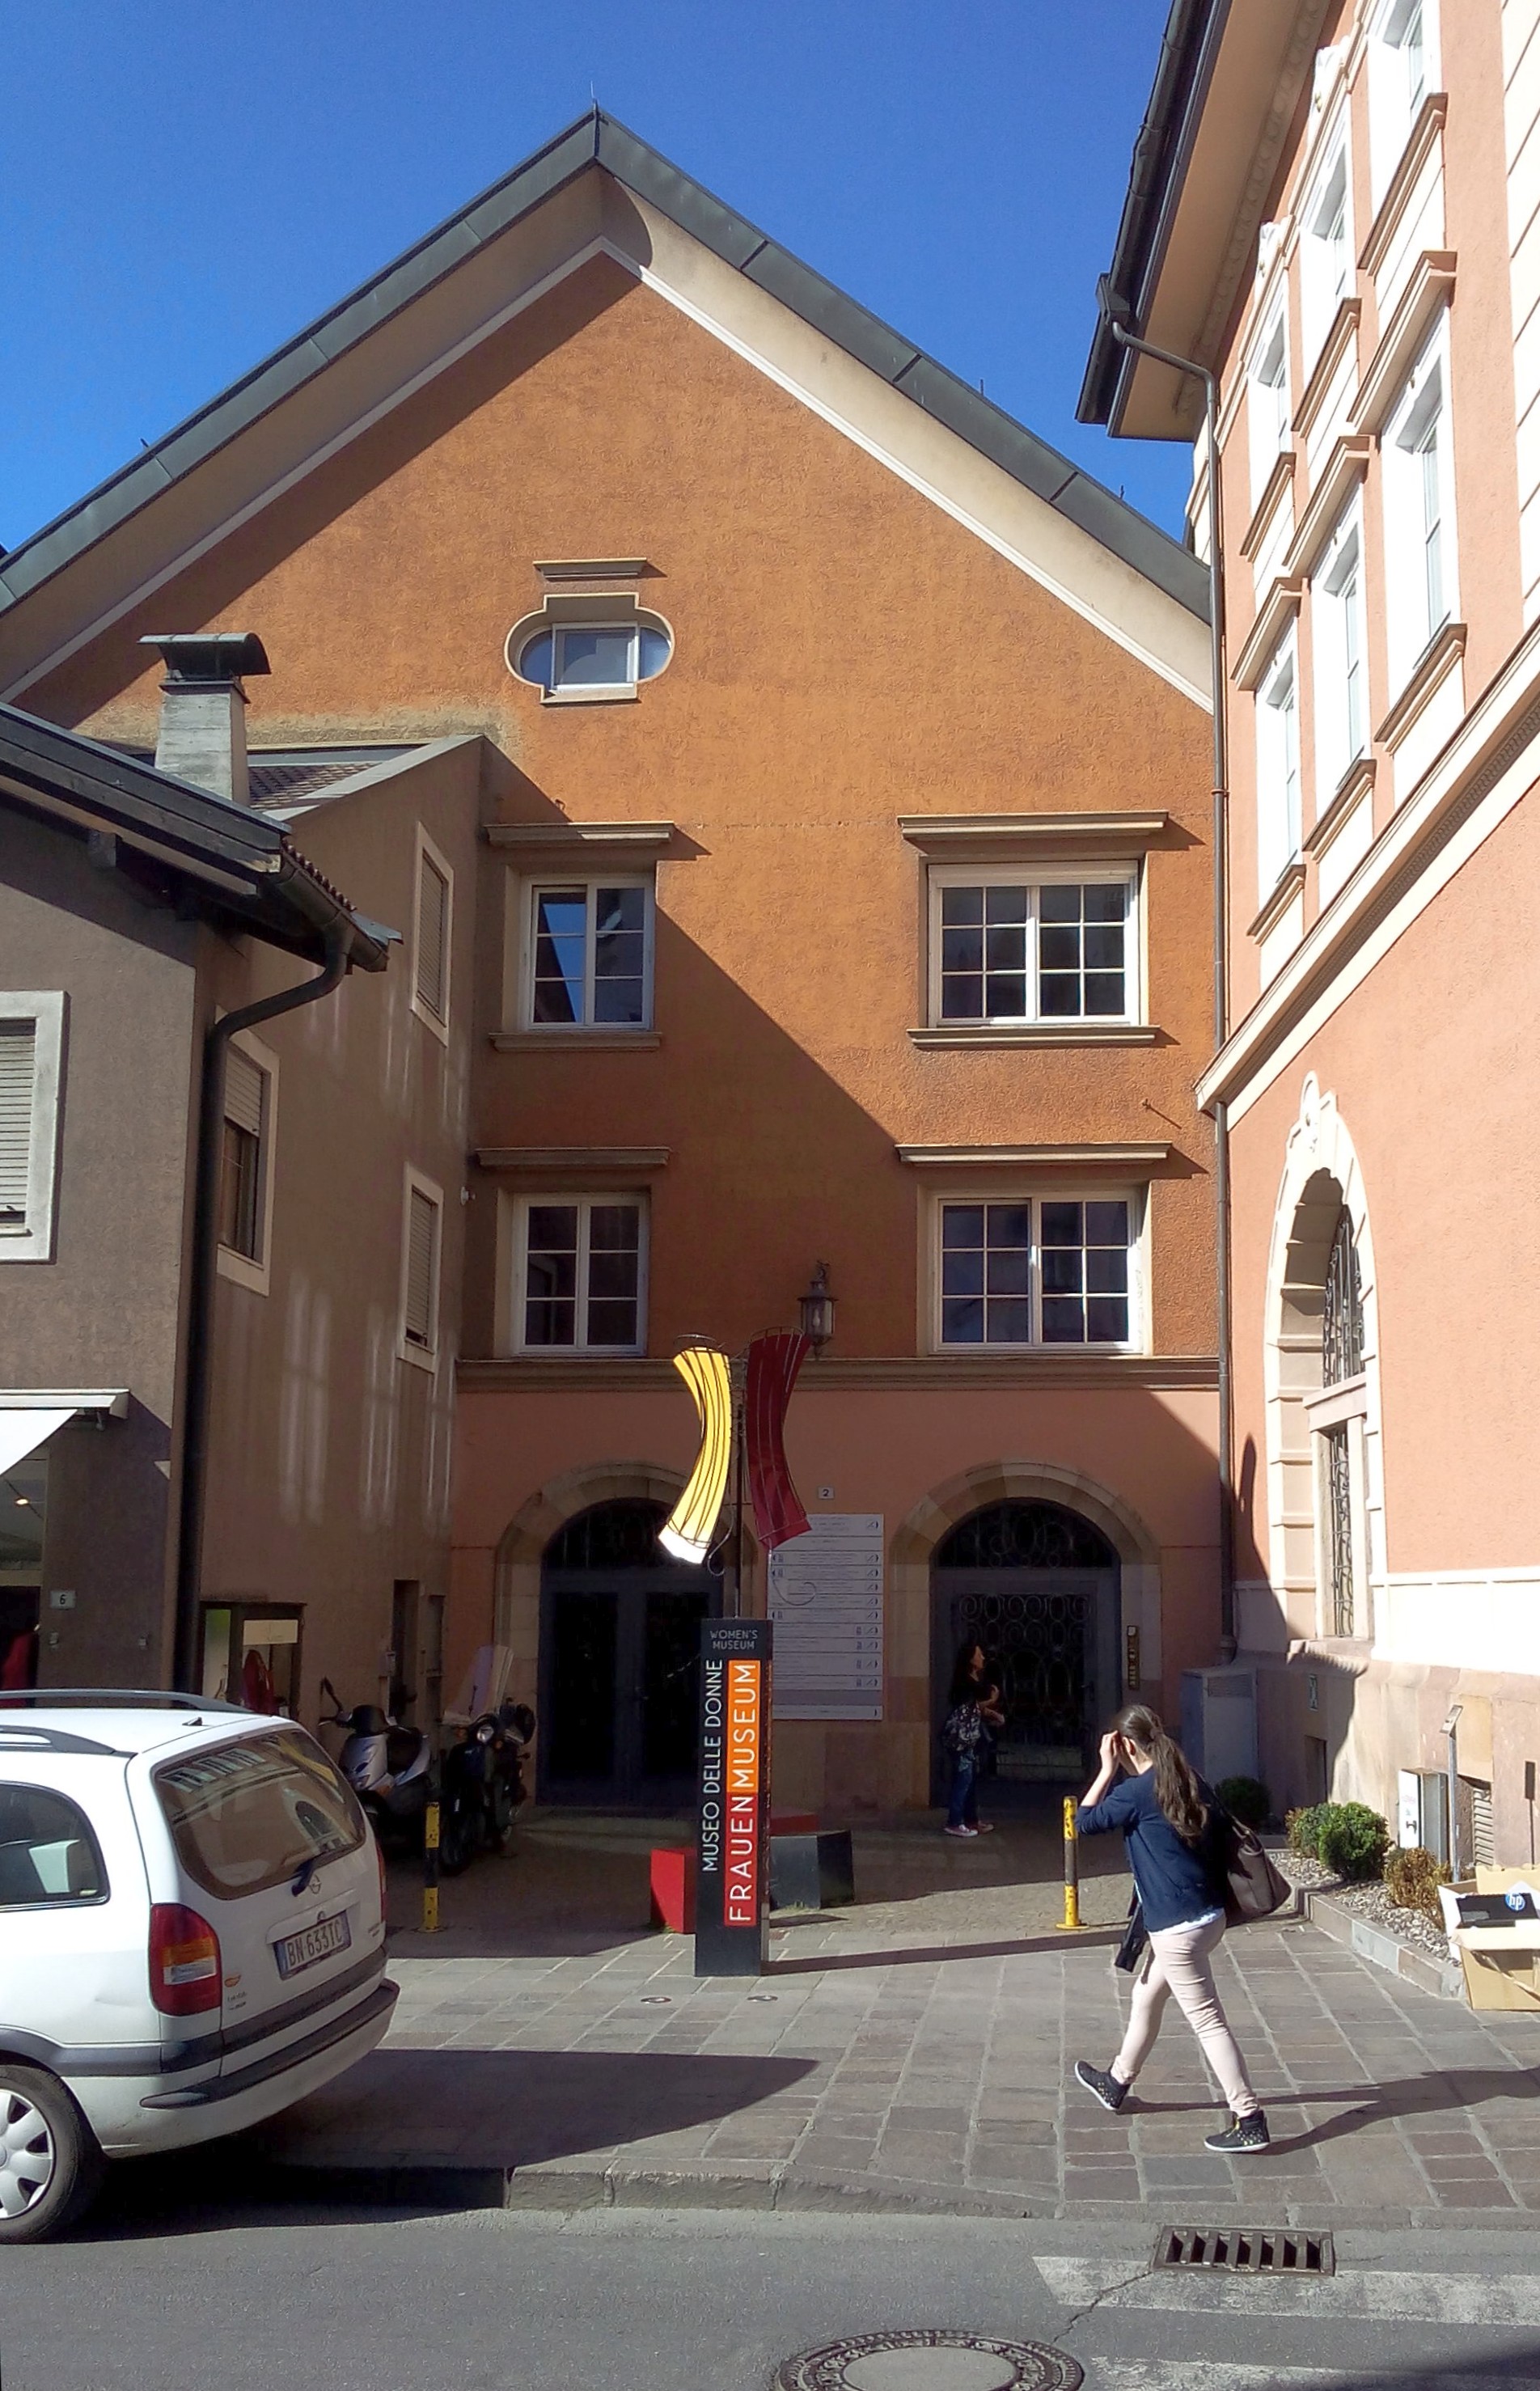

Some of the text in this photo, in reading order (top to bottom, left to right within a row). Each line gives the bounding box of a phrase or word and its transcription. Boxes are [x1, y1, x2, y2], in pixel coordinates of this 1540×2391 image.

[823, 1488, 829, 1496] 2
[60, 1594, 66, 1605] 6
[709, 1629, 758, 1640] WOMEN'S
[713, 1640, 755, 1649] MUSEUM
[702, 1660, 723, 1871] MUSEO DELLE DONNE
[1509, 1894, 1522, 1910] hp
[287, 1936, 304, 1966] BN
